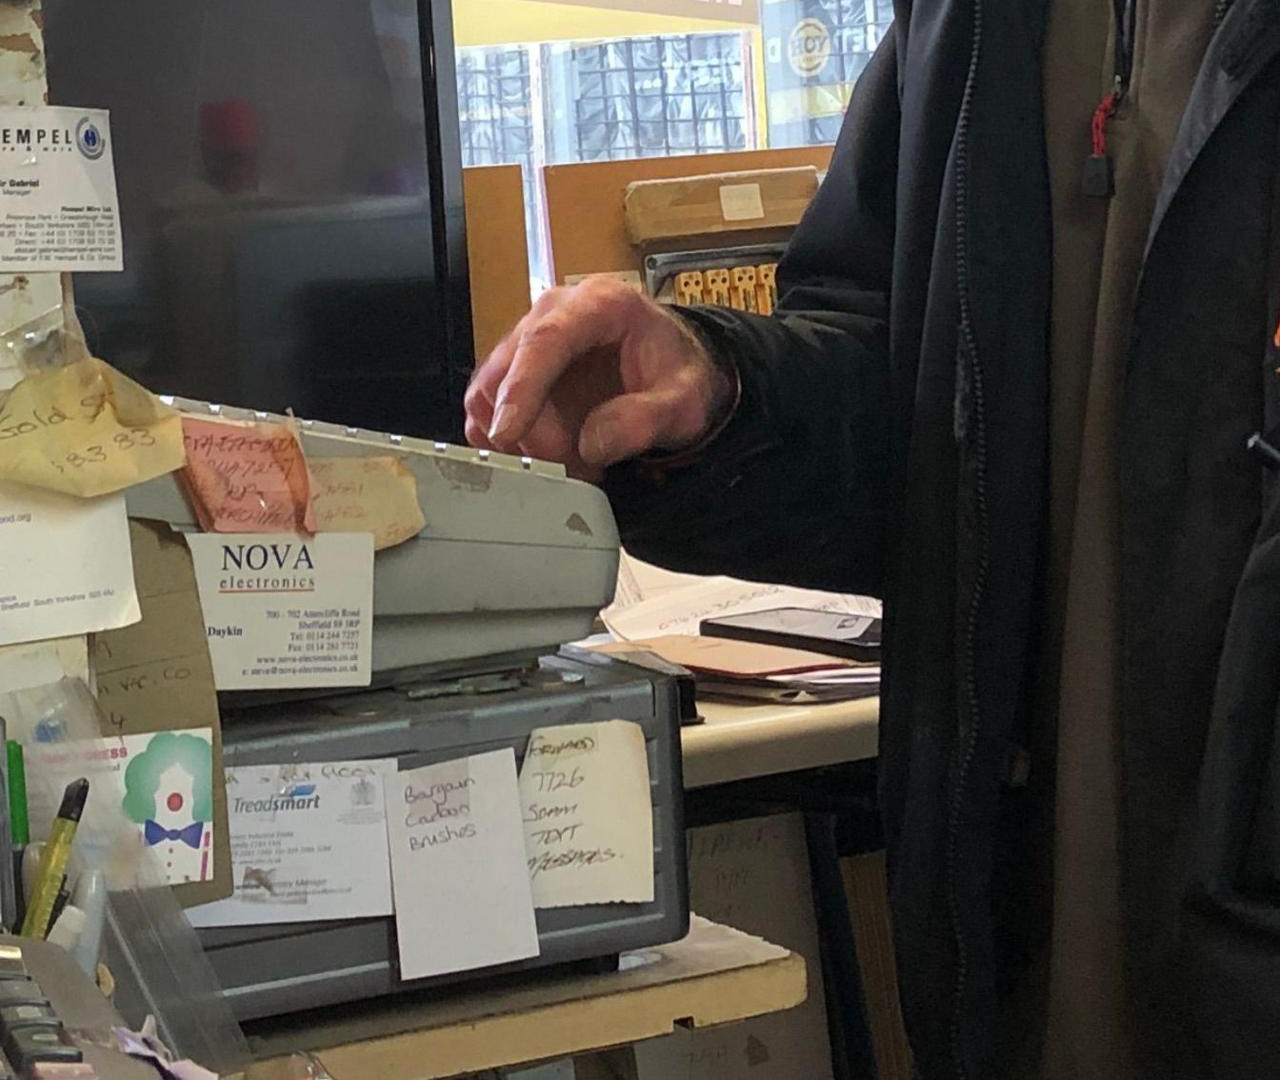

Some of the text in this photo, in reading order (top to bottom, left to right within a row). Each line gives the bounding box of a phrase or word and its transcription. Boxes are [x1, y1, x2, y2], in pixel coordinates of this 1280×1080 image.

[9, 179, 39, 188] Gabriel
[222, 544, 314, 570] NOVA
[220, 576, 314, 590] electronics
[207, 626, 242, 638] Daykin
[405, 777, 476, 805] Bargain
[533, 768, 584, 793] 7726
[234, 795, 320, 814] Treadsmart
[406, 804, 471, 827] Carbon
[409, 823, 477, 851] Brushes
